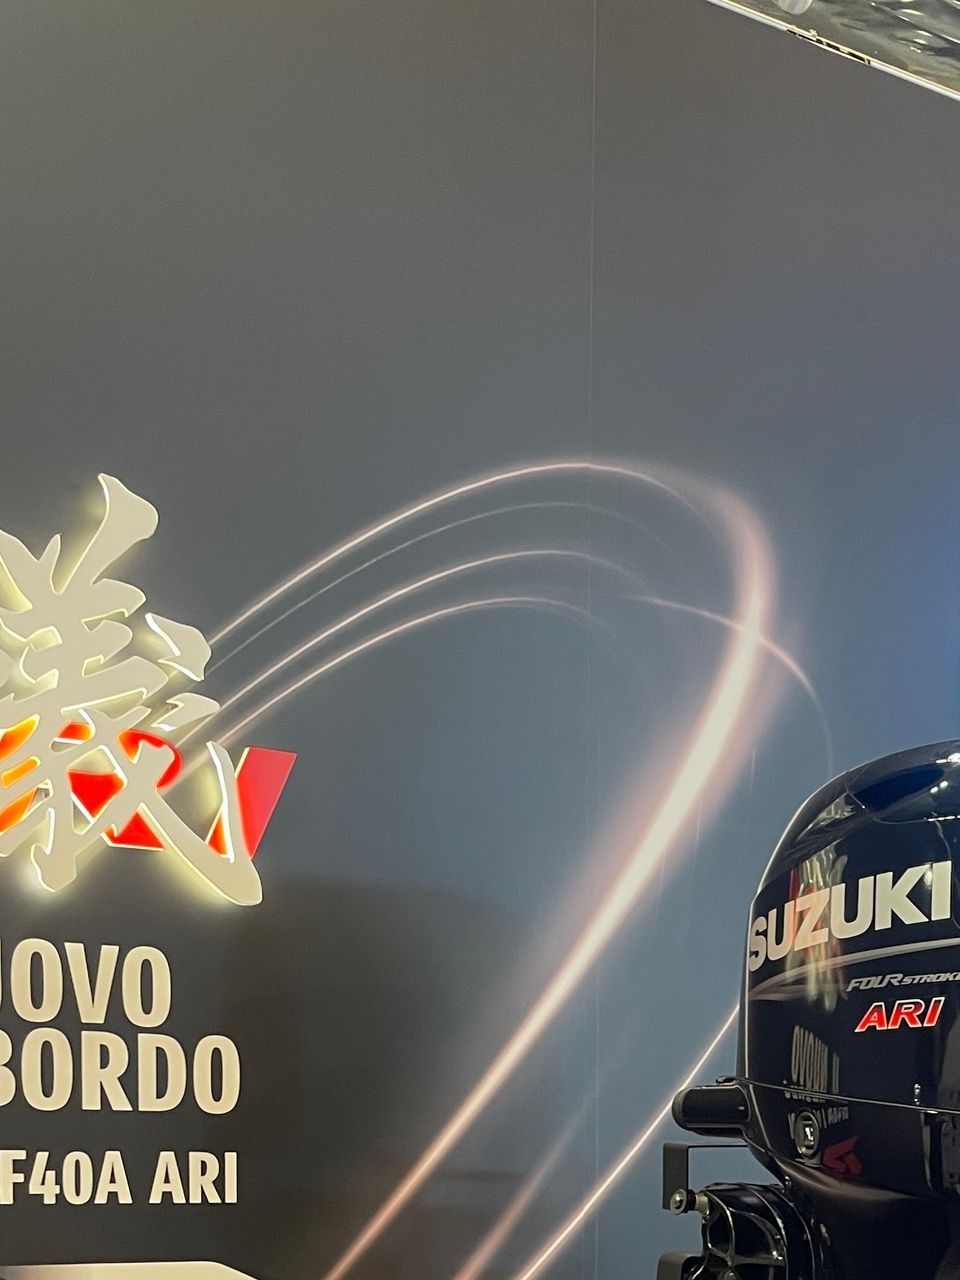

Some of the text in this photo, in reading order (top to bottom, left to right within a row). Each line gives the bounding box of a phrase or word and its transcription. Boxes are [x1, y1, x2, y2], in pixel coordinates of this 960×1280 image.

[748, 860, 953, 972] SUZUKI
[0, 938, 172, 1028] OVO
[854, 997, 945, 1032] ARI
[0, 1150, 238, 1205] F40A ARI
